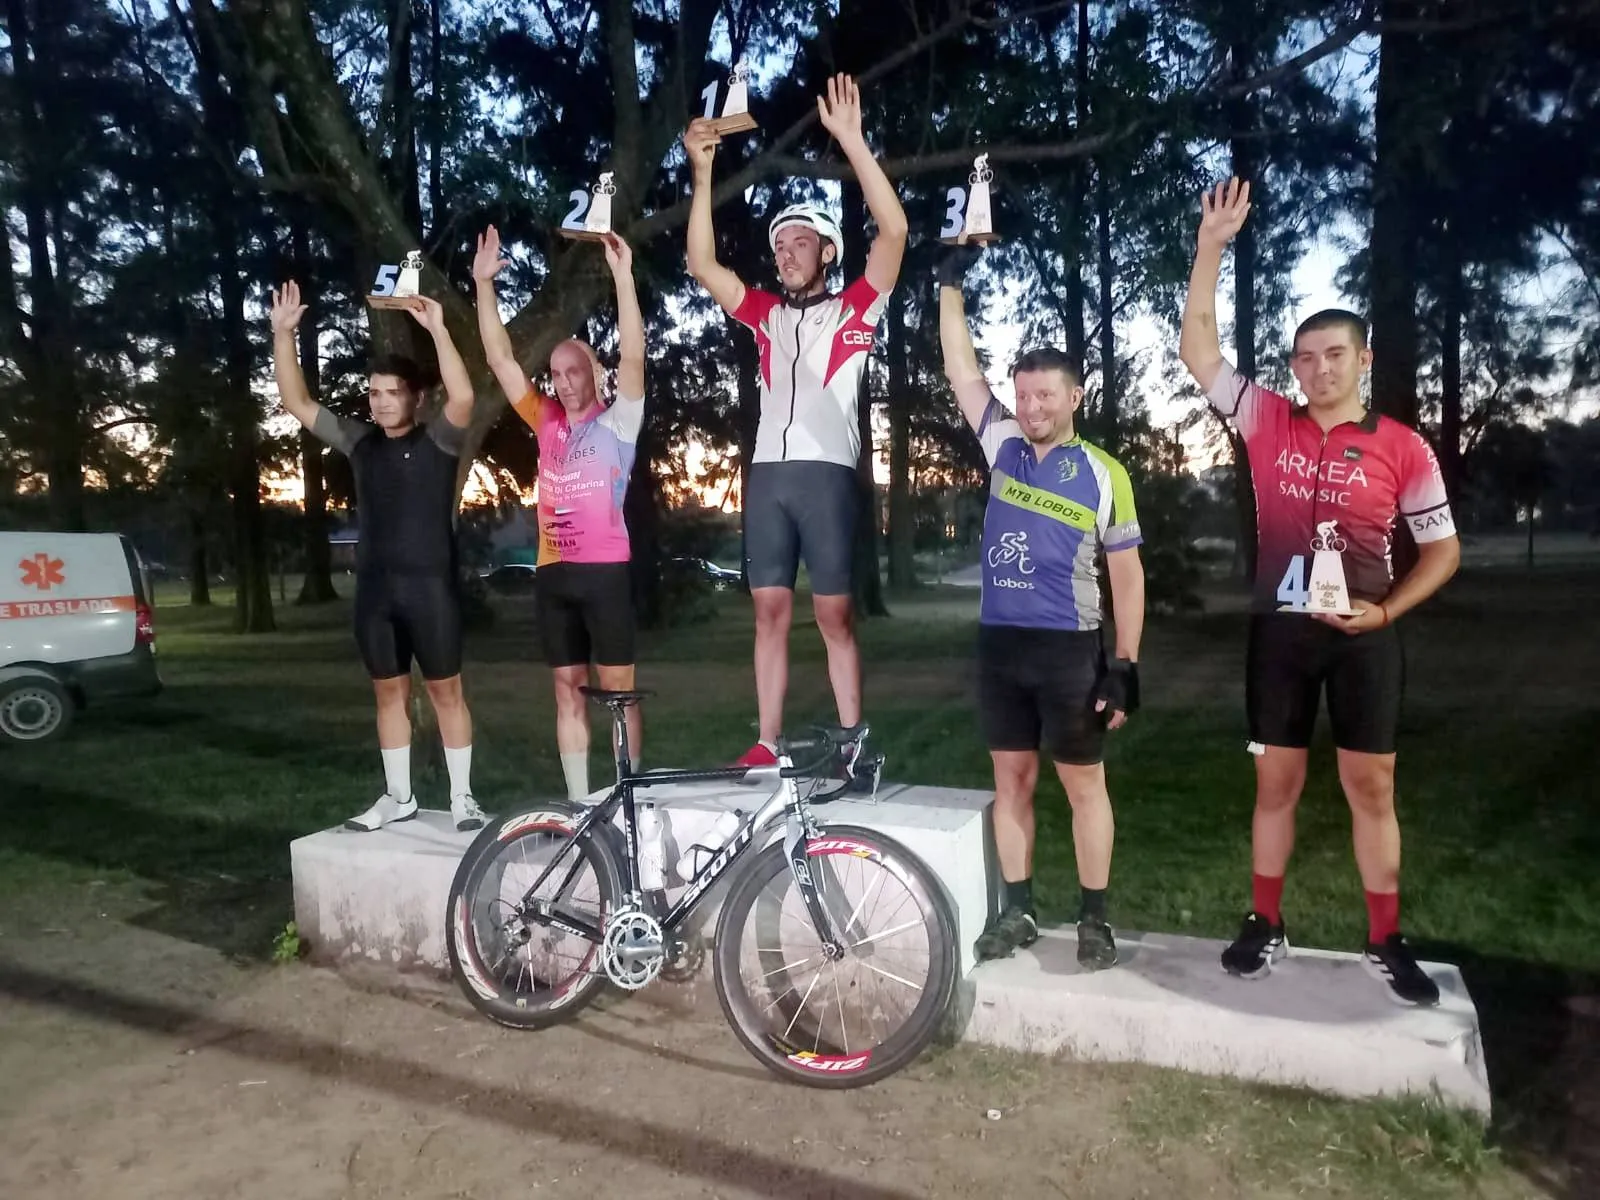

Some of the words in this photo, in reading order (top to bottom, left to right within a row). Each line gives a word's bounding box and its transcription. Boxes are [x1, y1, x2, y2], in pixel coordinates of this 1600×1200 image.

[701, 80, 718, 119] 1
[562, 189, 588, 229] 2
[941, 187, 966, 238] 3
[371, 264, 399, 296] 5
[565, 479, 605, 493] Catarina
[1275, 449, 1368, 488] ARKEA
[1004, 486, 1031, 503] MTB
[1034, 496, 1083, 521] LOBOS
[993, 576, 1035, 590] Lobos
[1277, 555, 1311, 608] 4
[16, 599, 113, 616] TRASLADO
[684, 813, 755, 908] SCOTT
